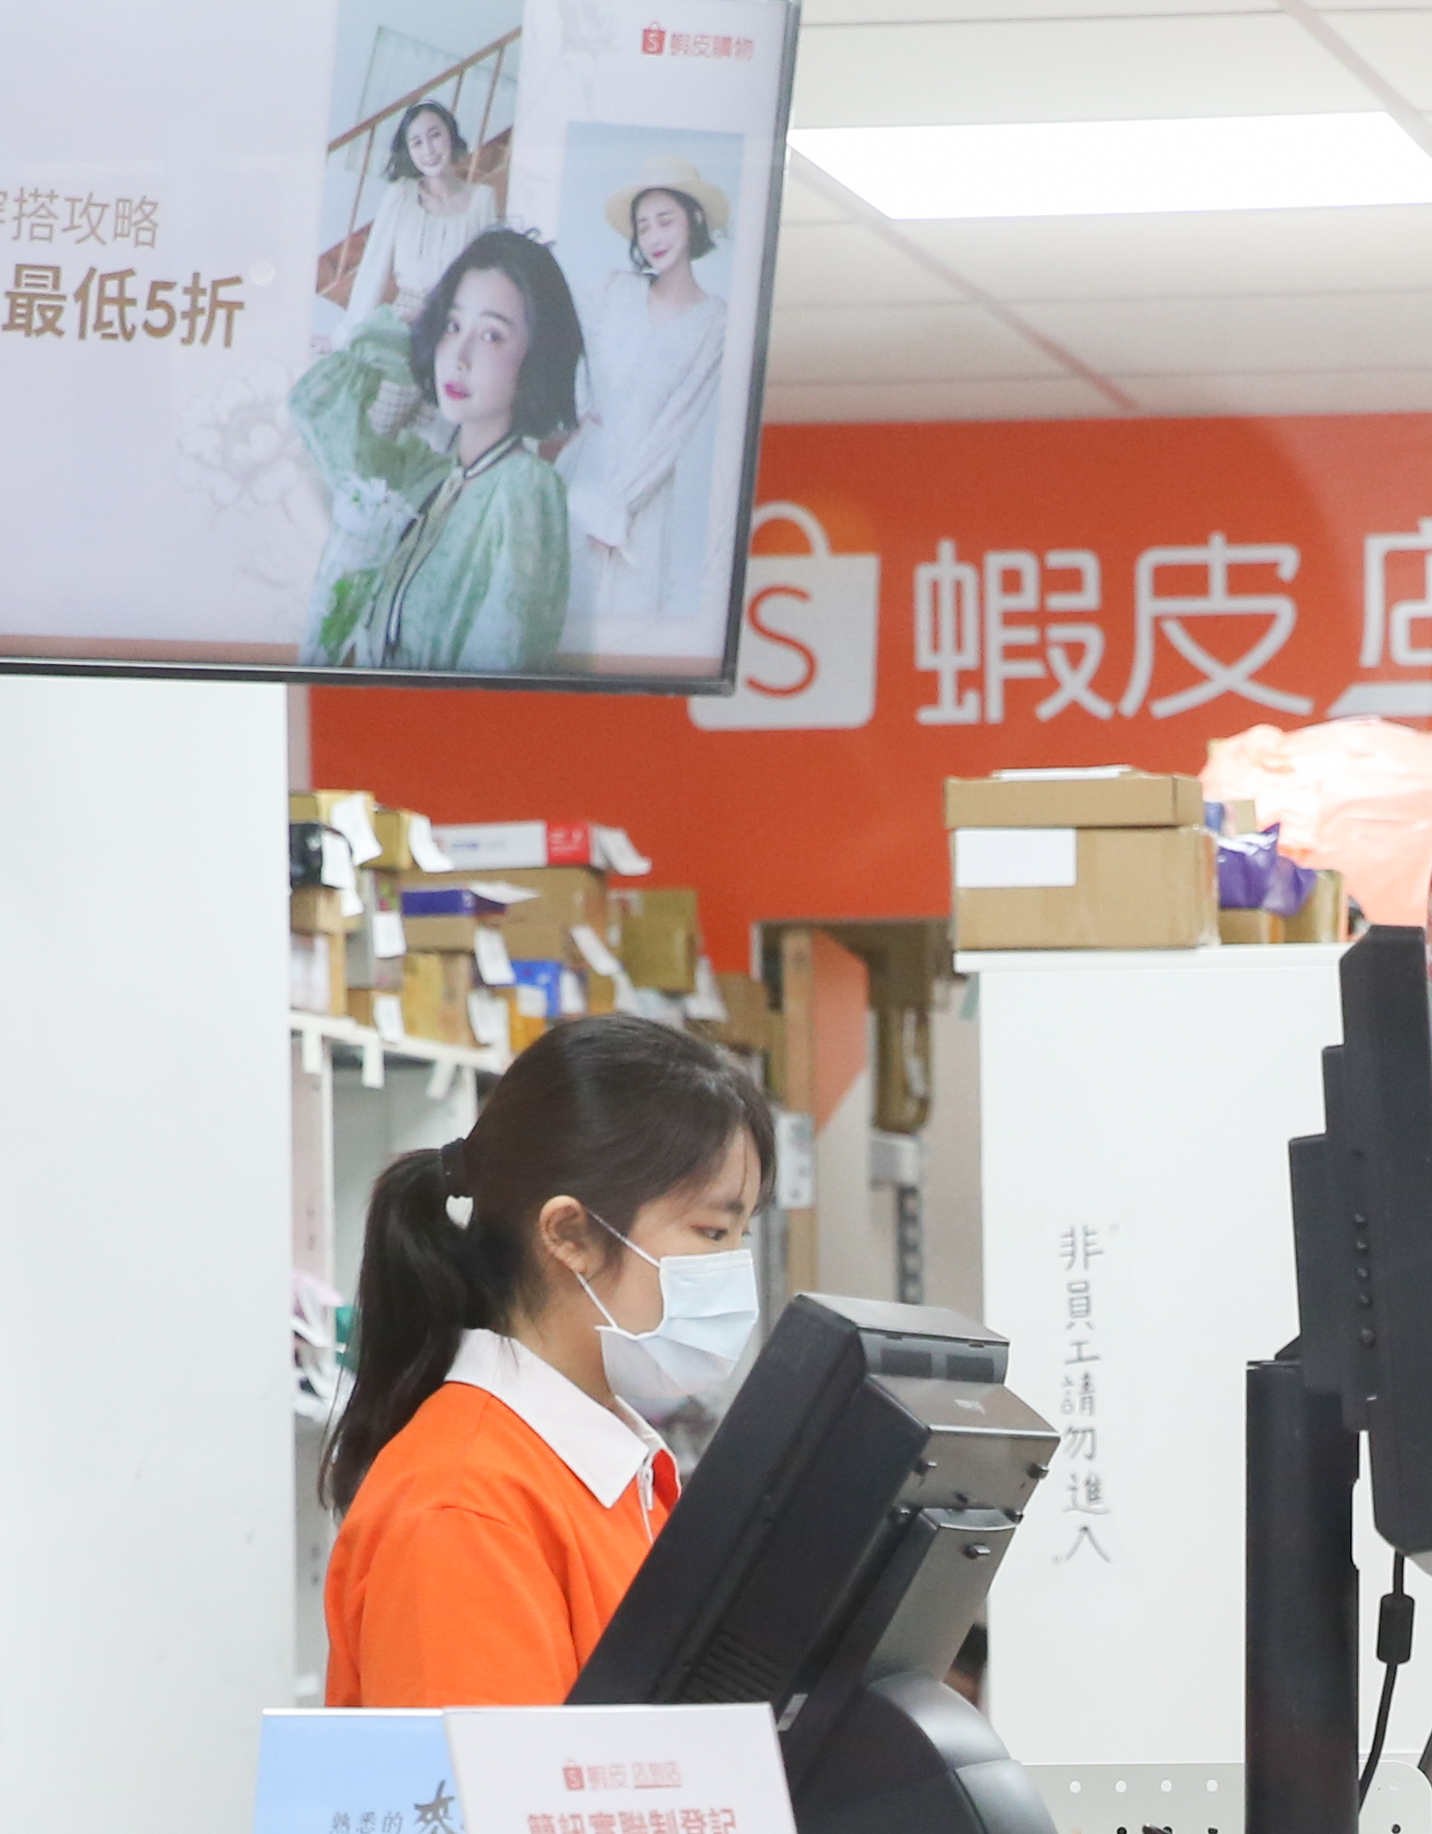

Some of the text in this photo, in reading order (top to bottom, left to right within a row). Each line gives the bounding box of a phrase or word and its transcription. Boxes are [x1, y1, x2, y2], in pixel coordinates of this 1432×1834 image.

[1060, 1224, 1111, 1563] 非員工請勿進入
